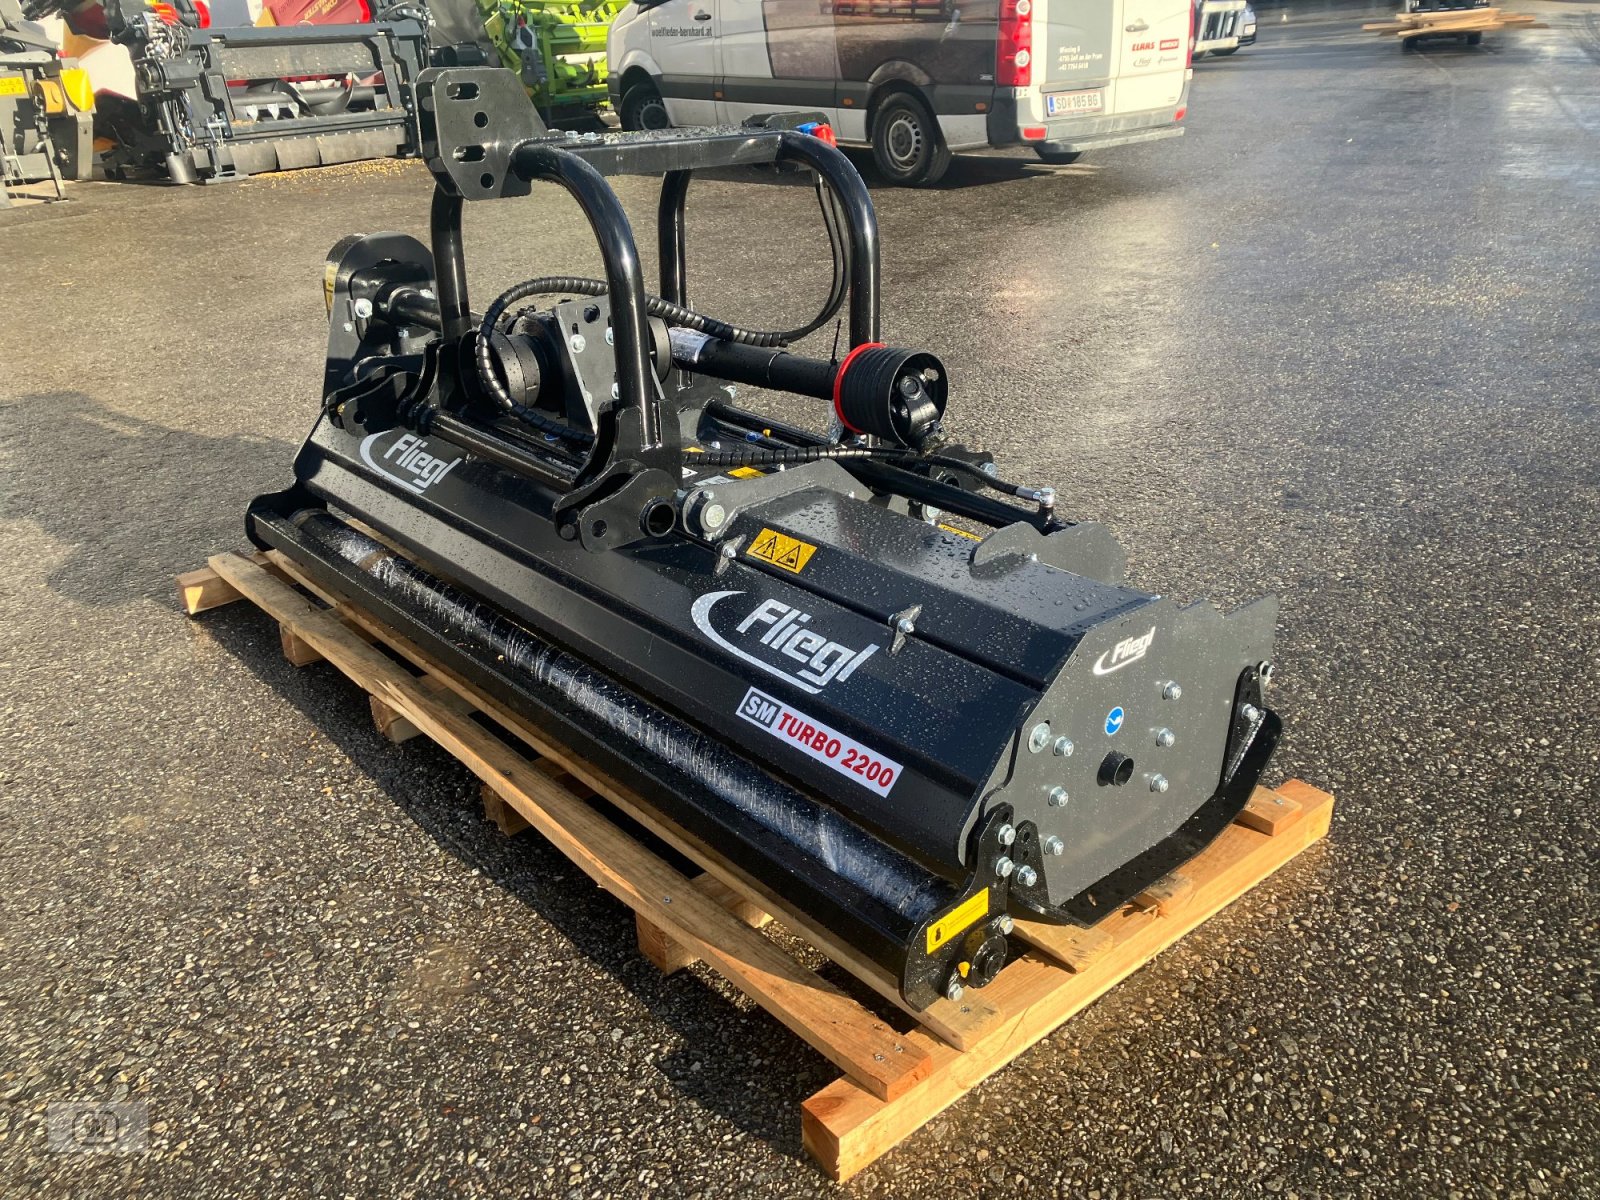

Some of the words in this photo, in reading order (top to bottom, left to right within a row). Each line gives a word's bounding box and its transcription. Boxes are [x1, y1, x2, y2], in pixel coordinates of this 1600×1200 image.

[1132, 42, 1155, 51] CLAAS
[384, 433, 462, 488] Fliegl
[736, 598, 880, 686] Fliegl
[1112, 626, 1156, 663] Fliegl
[744, 695, 778, 724] SM
[778, 711, 842, 759] TURBO
[841, 748, 894, 787] 2200
